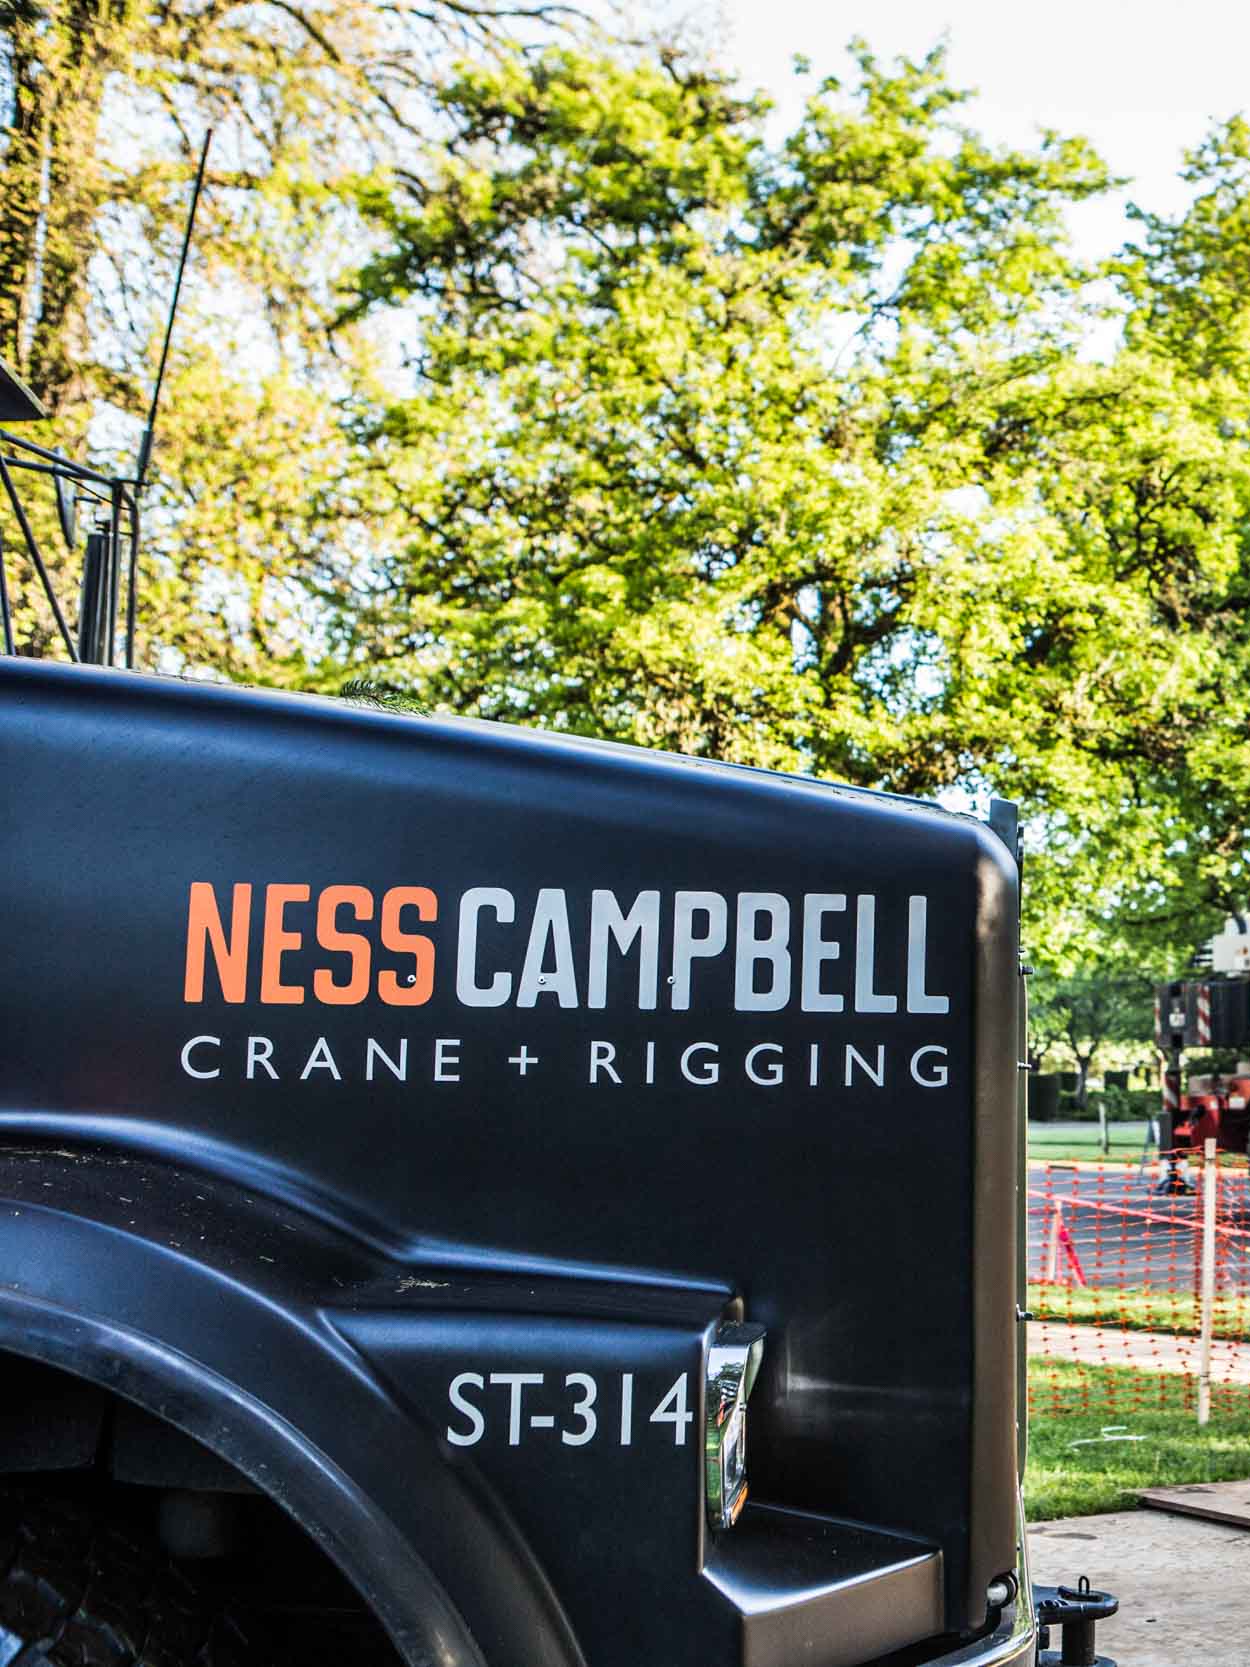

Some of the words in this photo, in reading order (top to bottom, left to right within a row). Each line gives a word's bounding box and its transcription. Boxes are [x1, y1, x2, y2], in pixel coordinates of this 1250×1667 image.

[183, 880, 437, 1006] NESS
[456, 886, 950, 1013] CAMPBELL
[180, 1035, 460, 1081] CRANE
[508, 1046, 538, 1075] +
[589, 1041, 949, 1088] RIGGING
[447, 1372, 693, 1446] ST-314
